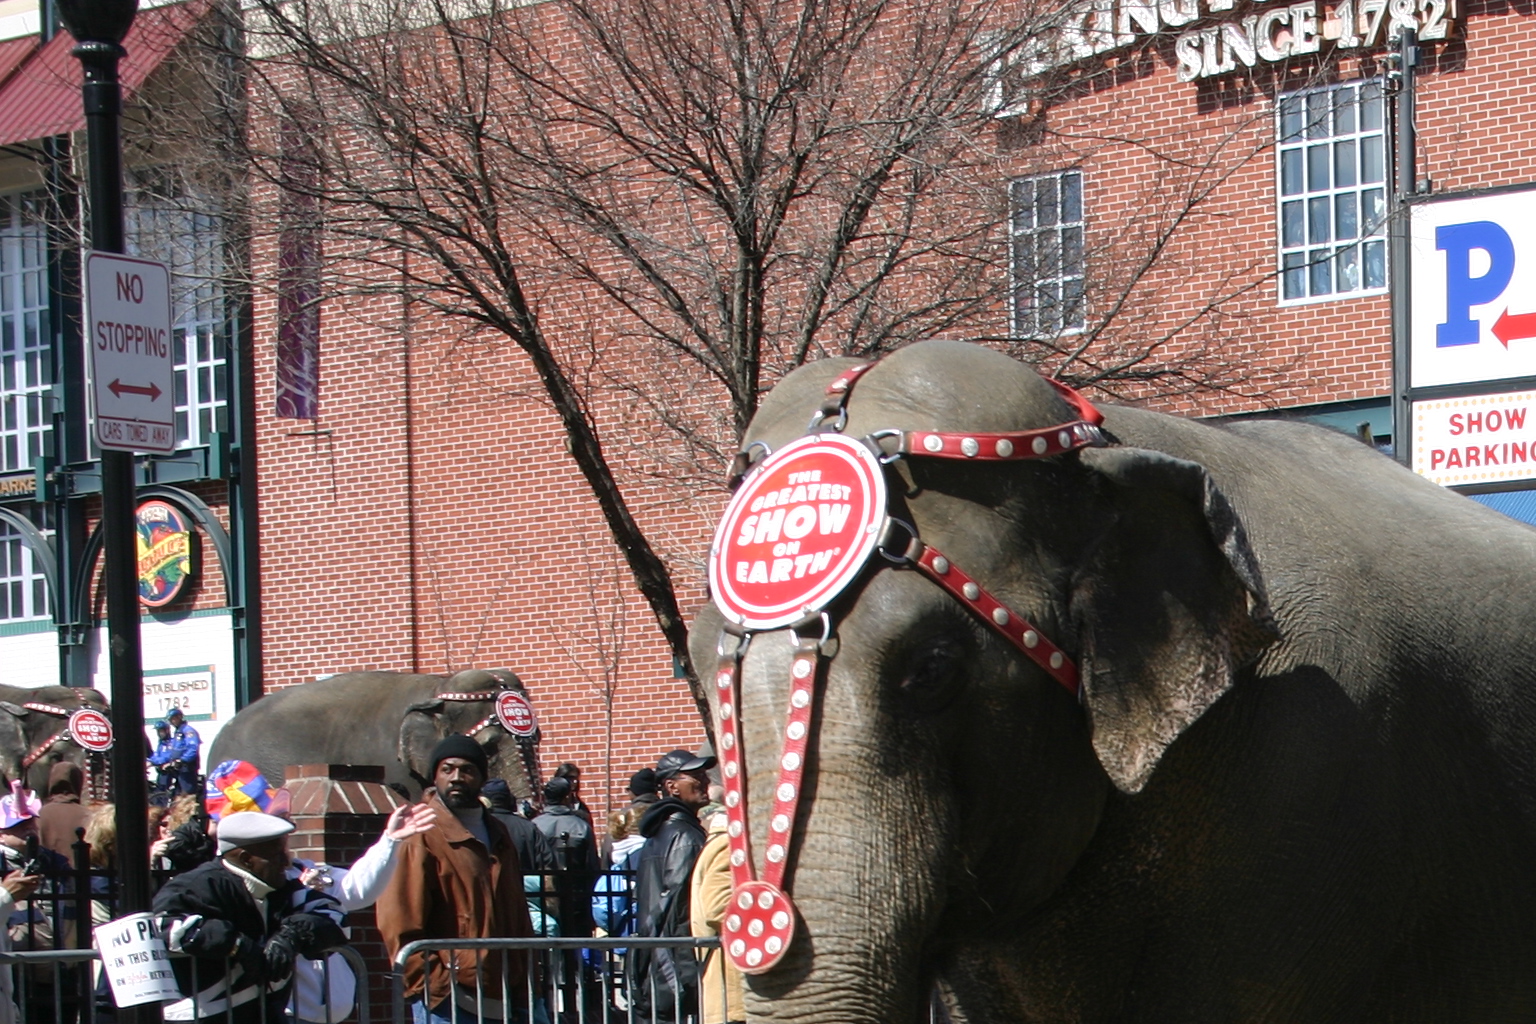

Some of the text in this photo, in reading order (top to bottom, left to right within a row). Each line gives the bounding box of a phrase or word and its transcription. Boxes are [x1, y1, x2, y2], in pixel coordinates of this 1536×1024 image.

[1176, 0, 1448, 82] SINCE 1782
[116, 271, 143, 304] NO
[1435, 221, 1515, 348] P
[97, 320, 167, 359] STOPPING
[102, 421, 170, 445] CARS TOWED AWAY
[1449, 407, 1527, 436] SHOW
[0, 478, 36, 494] ARKE
[788, 470, 822, 485] THE
[751, 483, 851, 513] GREATEST
[737, 503, 851, 546] SHOW
[772, 541, 801, 557] ON
[144, 680, 209, 695] STABLISHED
[159, 696, 190, 711] 1782
[136, 918, 160, 941] PA
[127, 950, 150, 965] THIS
